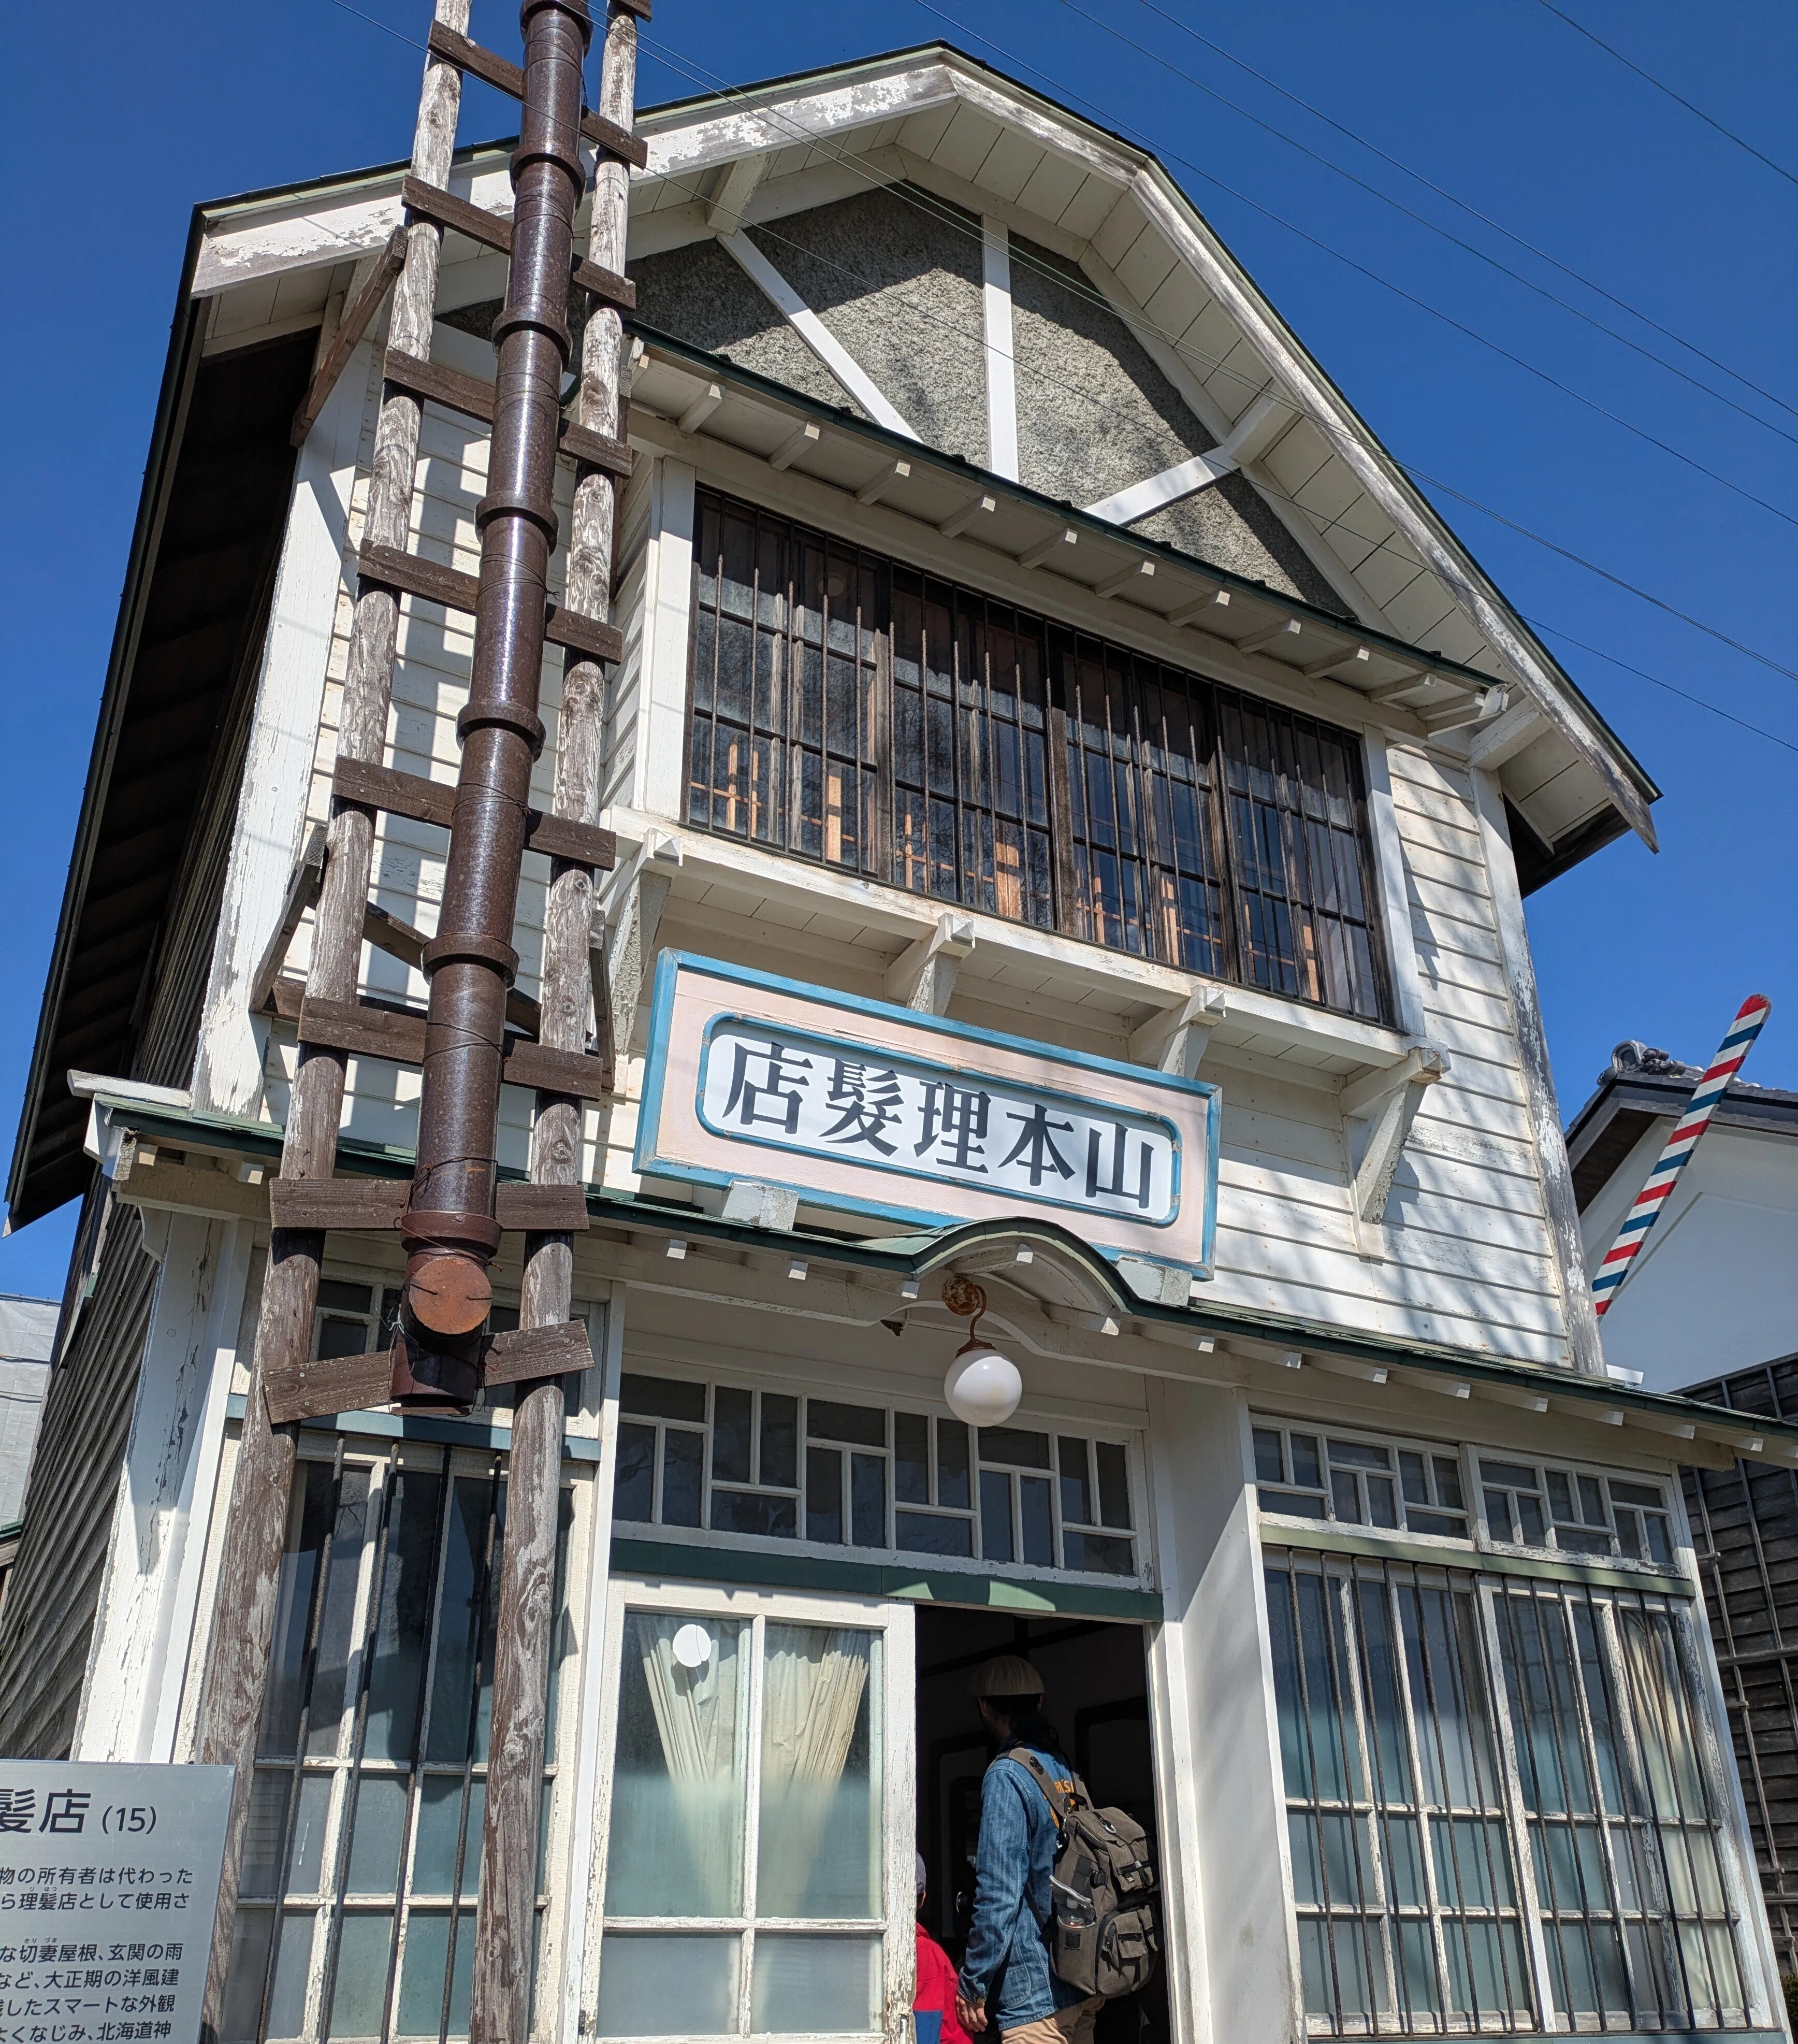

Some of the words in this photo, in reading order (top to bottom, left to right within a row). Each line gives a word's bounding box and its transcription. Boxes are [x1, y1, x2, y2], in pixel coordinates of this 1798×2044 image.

[102, 1805, 156, 1834] (15)
[0, 1867, 193, 1884] 物の所有者は代わった
[2, 1892, 190, 1910] ら理髪店として使用さ
[0, 1994, 176, 2017] したスマートな外観
